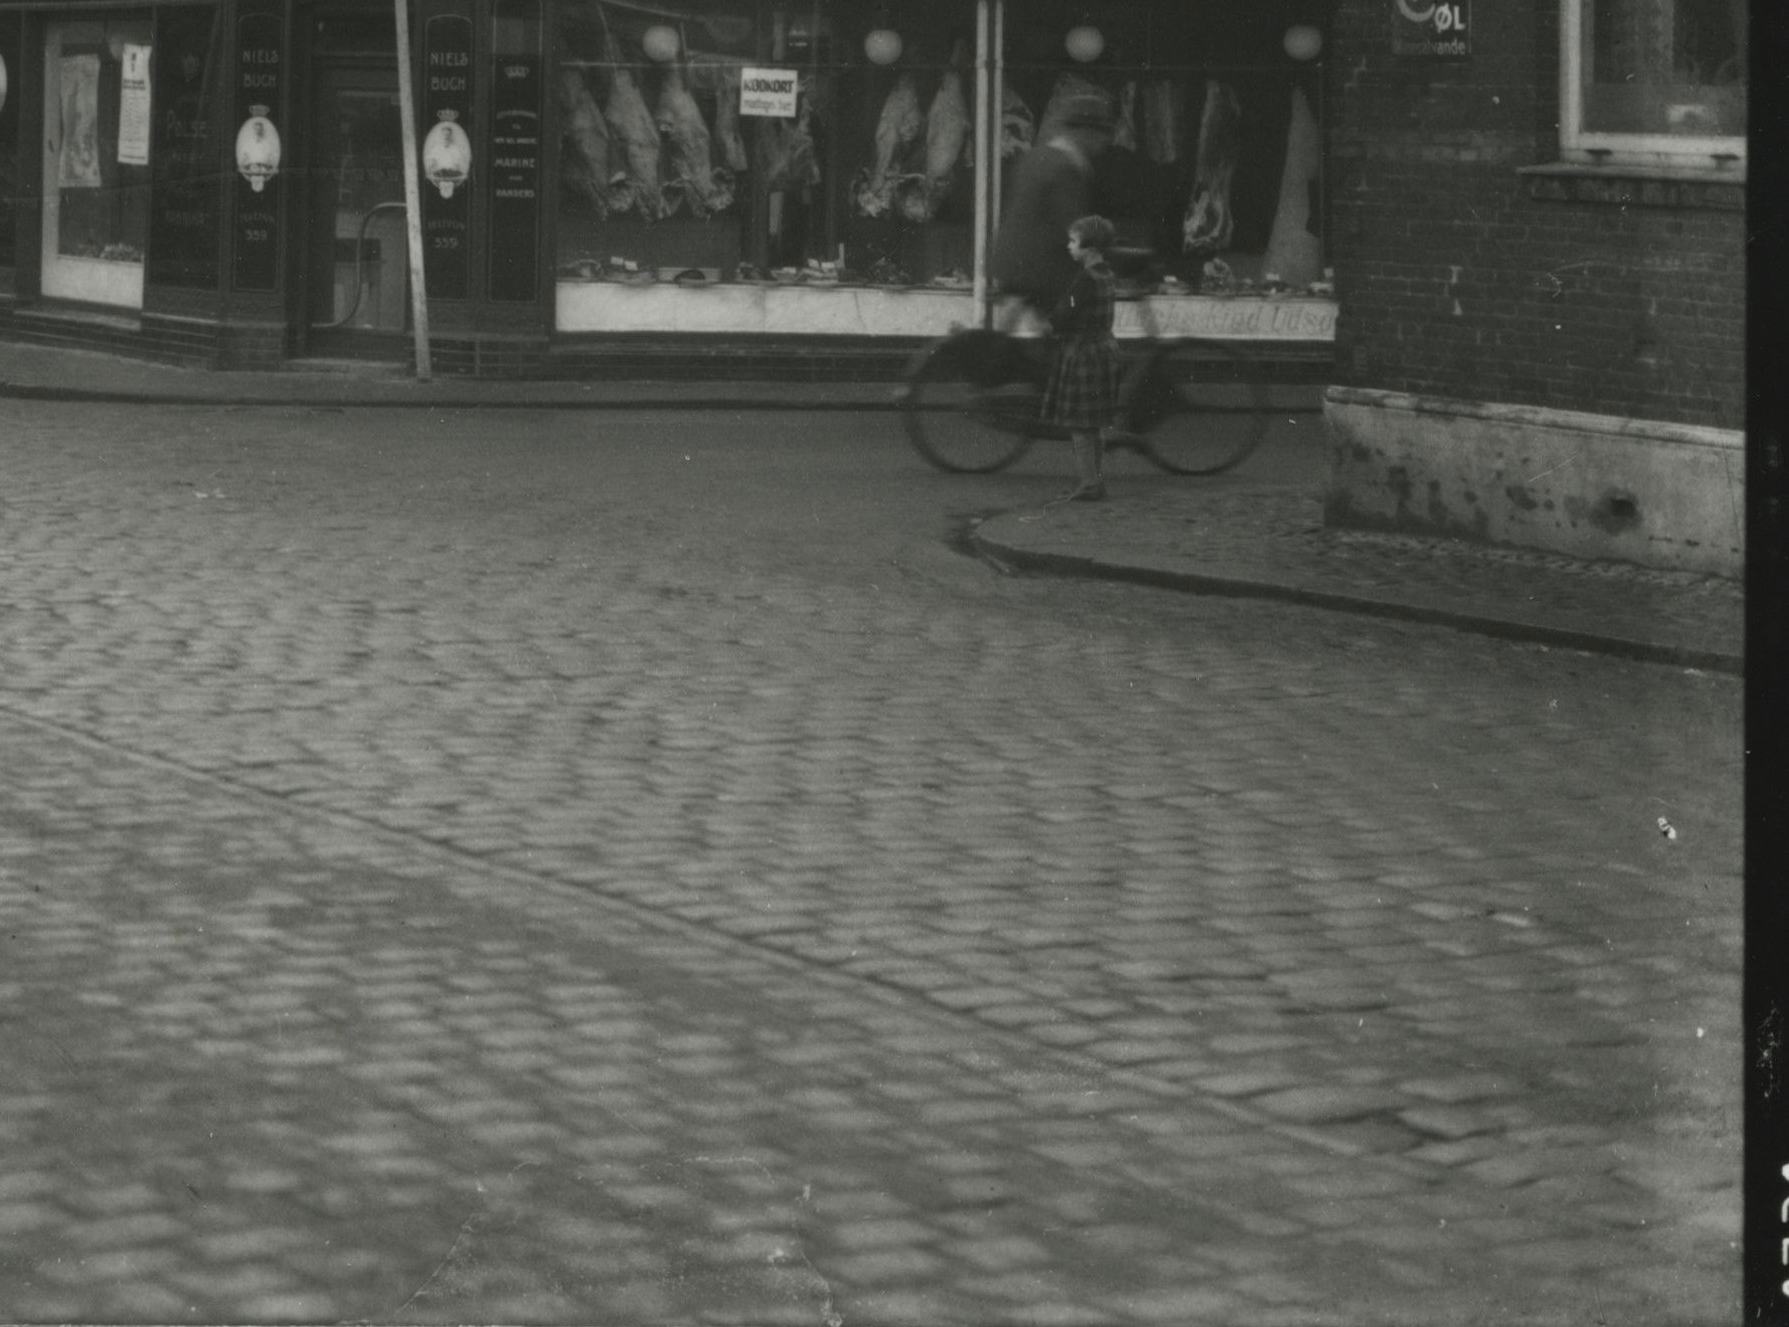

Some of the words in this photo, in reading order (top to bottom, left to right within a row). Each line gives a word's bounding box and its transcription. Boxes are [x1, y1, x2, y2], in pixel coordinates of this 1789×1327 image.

[1434, 3, 1466, 34] ØL
[242, 50, 279, 63] NIELS
[430, 52, 468, 66] NIELS
[243, 73, 276, 87] BUCH
[431, 76, 466, 91] BUCH
